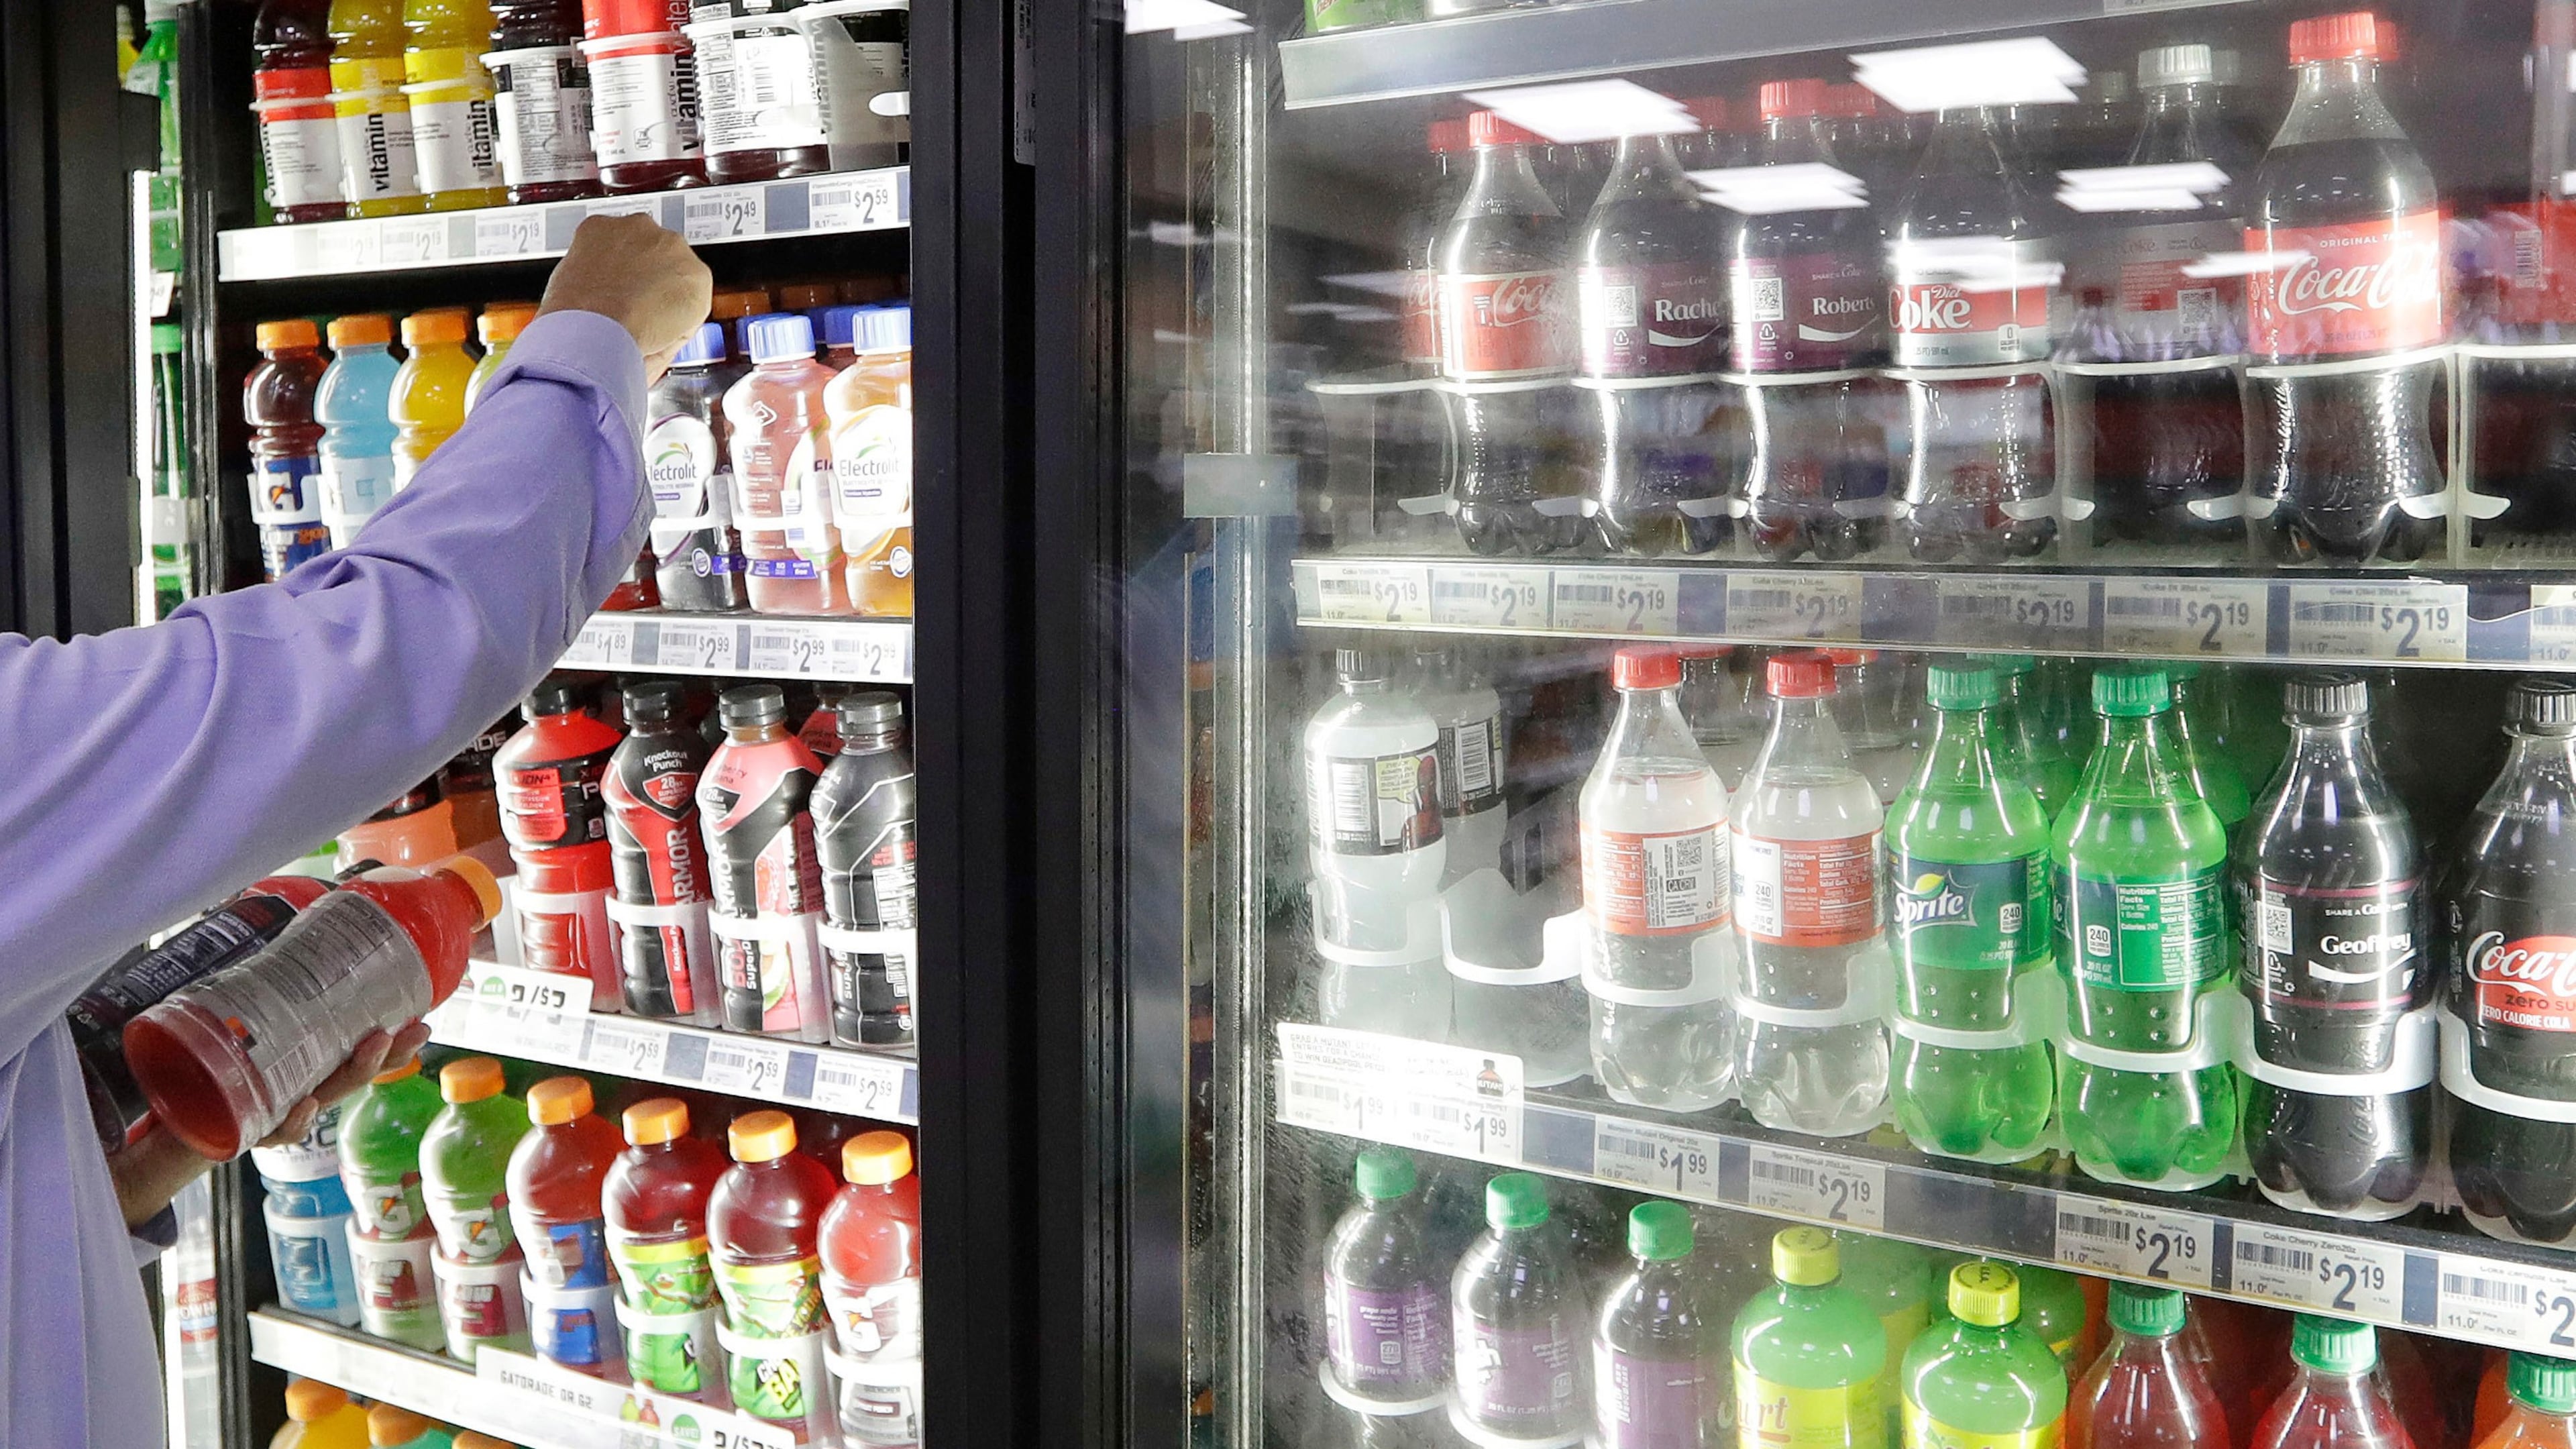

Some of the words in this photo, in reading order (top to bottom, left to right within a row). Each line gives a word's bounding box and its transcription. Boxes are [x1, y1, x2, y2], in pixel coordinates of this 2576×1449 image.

[674, 53, 698, 151] vitamin
[366, 113, 390, 192] vitamin
[468, 101, 496, 181] vitamin
[724, 201, 757, 235] $249
[854, 189, 889, 223] $259
[511, 223, 540, 254] $219
[2318, 235, 2379, 248] ORIGINAL
[1931, 284, 1961, 299] Diet
[1888, 288, 1972, 329] Coke
[839, 458, 900, 478] Electrolit
[1375, 582, 1418, 622] $219
[1490, 584, 1536, 626] $219
[1617, 588, 1665, 631] $219
[1794, 592, 1848, 638] $219
[2186, 600, 2250, 651] $219
[2381, 604, 2449, 657] $219
[596, 636, 627, 663] $189
[698, 637, 730, 669] $299
[792, 639, 824, 672] $299
[863, 642, 896, 676] $299
[2539, 646, 2571, 661] 11.0¢
[644, 749, 688, 767] Knockout
[653, 759, 683, 772] Punch
[1755, 883, 1772, 898] 240
[2118, 886, 2157, 896] Nutrition
[2119, 895, 2144, 904] Facts
[1893, 885, 1965, 931] Sprite
[2002, 906, 2021, 920] 240
[2324, 908, 2354, 917] SHARE
[2361, 902, 2390, 916] Coke
[2090, 928, 2109, 943] 240
[2319, 932, 2412, 956] Geoffrey
[2094, 961, 2102, 971] FL
[2505, 993, 2549, 1010] zero
[2483, 1004, 2502, 1020] ZERO
[2502, 1008, 2542, 1028] CALORIE
[2543, 1015, 2571, 1030] COLA
[629, 1037, 659, 1071] $259
[1320, 1037, 1351, 1049] MUTANT
[1293, 1051, 1303, 1059] TO
[1305, 1053, 1320, 1063] WIN
[1322, 1055, 1363, 1069] DEADPOOL
[746, 1061, 778, 1091] $259
[859, 1077, 893, 1111] $259
[1343, 1095, 1383, 1130] $199
[1464, 1112, 1507, 1155] $199
[1659, 1146, 1708, 1191] $199
[1771, 1150, 1794, 1161] Sprite
[1794, 1155, 1824, 1165] Tropical
[1818, 1173, 1871, 1222] $219
[2098, 1204, 2123, 1216] Sprite
[2135, 1226, 2196, 1279] $219
[2263, 1230, 2287, 1242] Coke
[2288, 1235, 2319, 1249] Cherry
[2062, 1249, 2089, 1263] 11.0¢
[2239, 1279, 2268, 1294] 11.0¢
[2319, 1255, 2385, 1311] $219
[2447, 1313, 2478, 1330] 11.0¢
[500, 1370, 555, 1399] GATORADE
[559, 1388, 575, 1403] OR
[578, 1393, 593, 1409] G2
[673, 1424, 699, 1439] SAVE!
